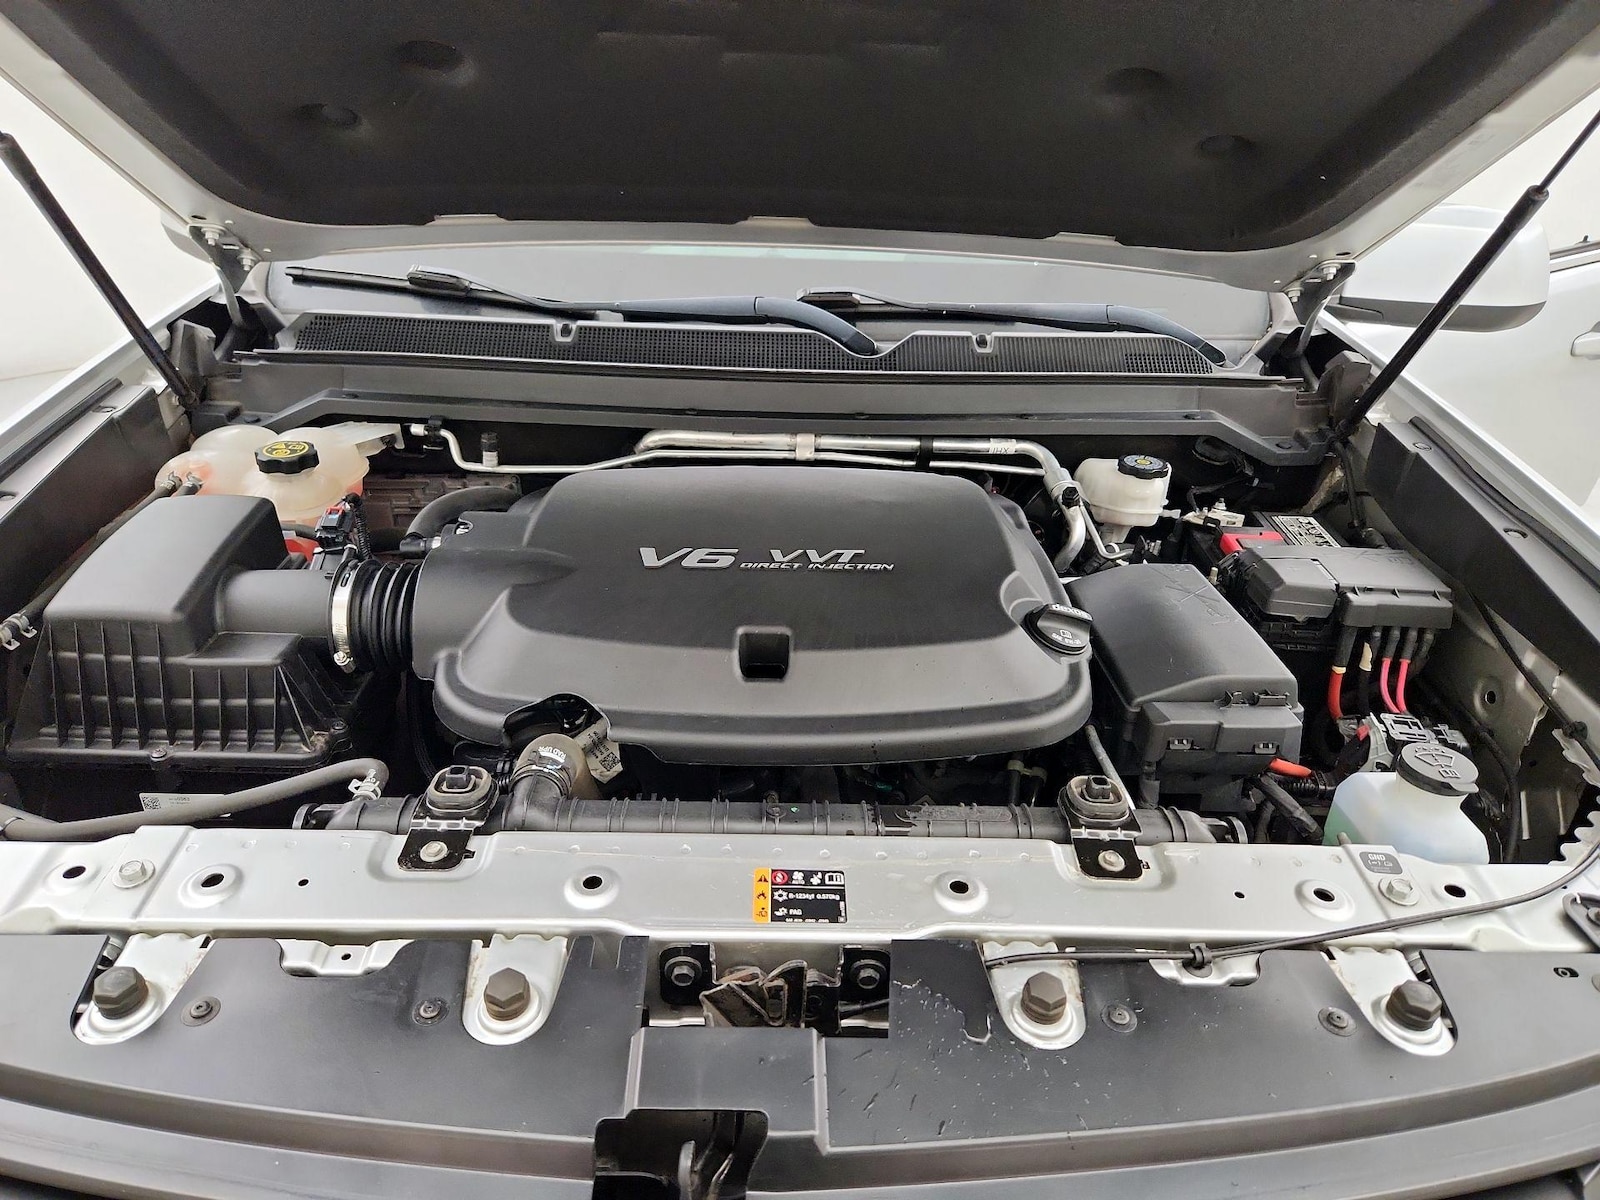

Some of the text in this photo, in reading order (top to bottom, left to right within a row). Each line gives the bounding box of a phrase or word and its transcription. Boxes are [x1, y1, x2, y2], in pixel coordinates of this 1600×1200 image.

[639, 546, 739, 569] V6
[769, 548, 866, 563] VVT
[739, 562, 895, 571] DIRECT INJECTION
[552, 748, 567, 759] RAD
